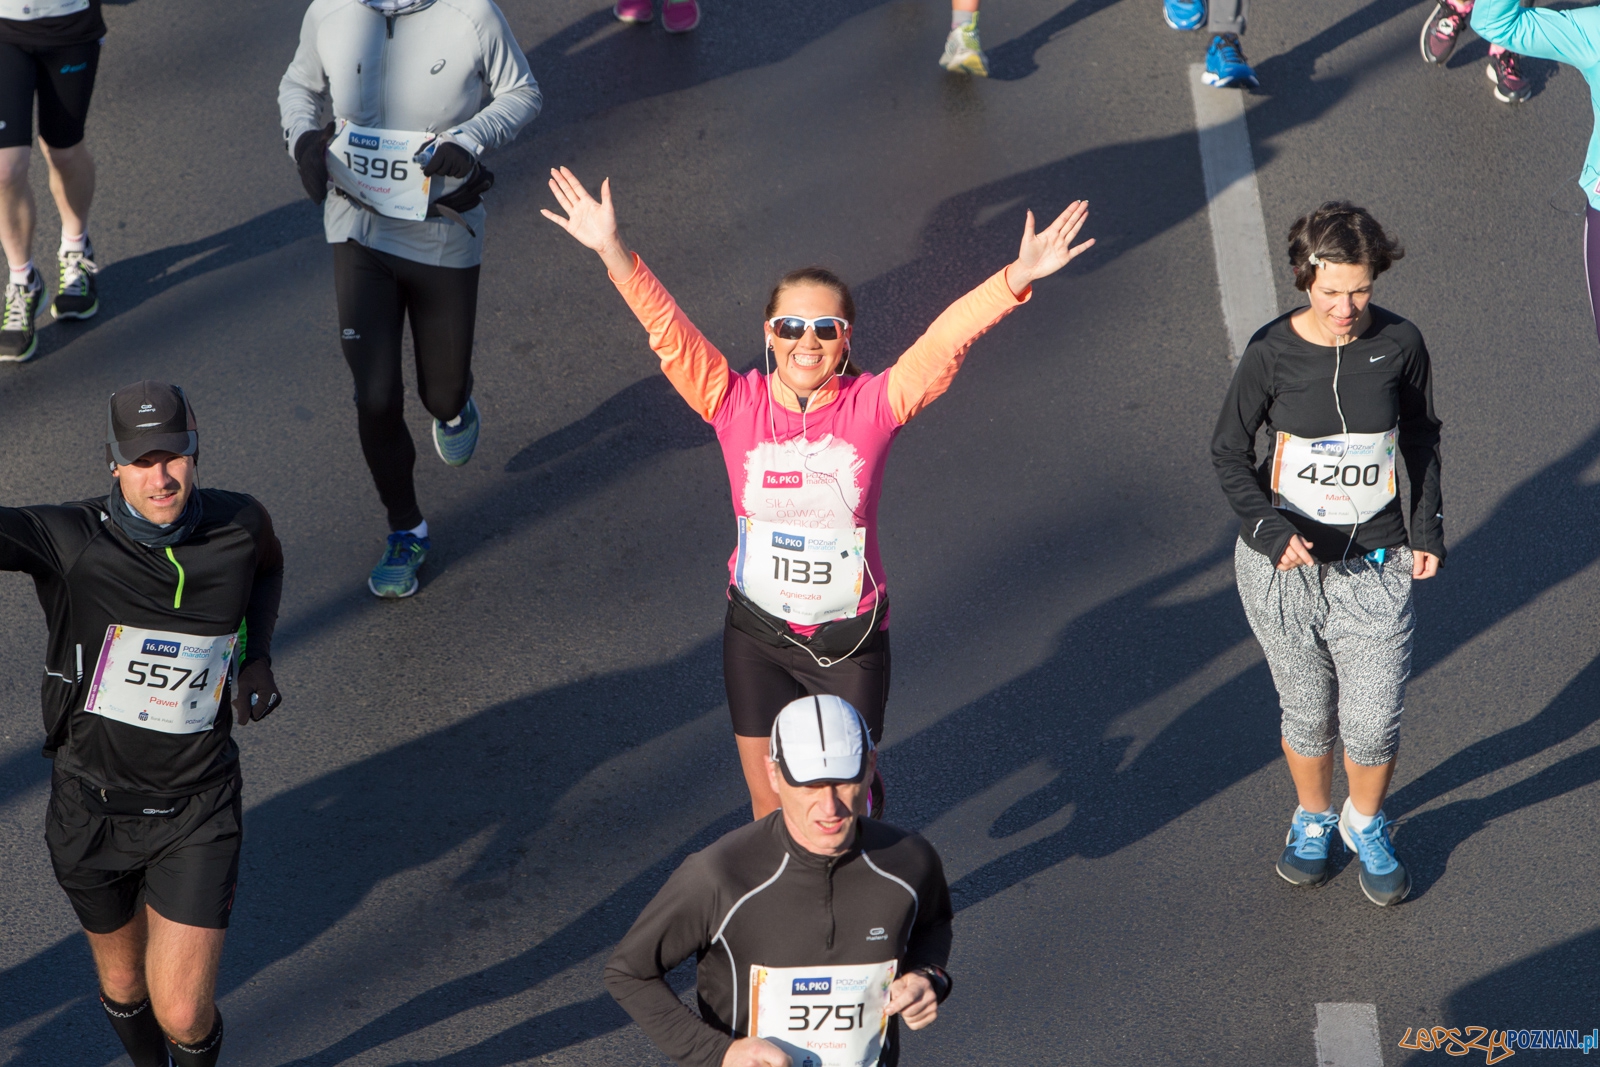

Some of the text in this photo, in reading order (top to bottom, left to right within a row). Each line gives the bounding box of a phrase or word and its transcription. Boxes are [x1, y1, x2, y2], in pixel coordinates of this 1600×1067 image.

[350, 136, 377, 147] 16. PKO
[344, 151, 408, 181] 1396
[358, 180, 391, 194] Krzysztof
[1326, 443, 1342, 453] PKO
[766, 475, 799, 484] 16. PKO
[1297, 462, 1379, 486] 4200
[765, 498, 795, 509] SIŁA
[776, 509, 835, 519] ODWAGA
[774, 536, 802, 547] 16. PKO
[772, 555, 832, 585] 1133
[780, 589, 822, 600] Agnieszka
[145, 643, 177, 654] 16. PKO
[181, 651, 210, 659] maraton
[124, 660, 210, 691] 5574
[149, 696, 179, 708] Paweł
[794, 982, 829, 991] 16. PKO
[788, 1002, 865, 1031] 3751
[806, 1040, 847, 1050] Krystian
